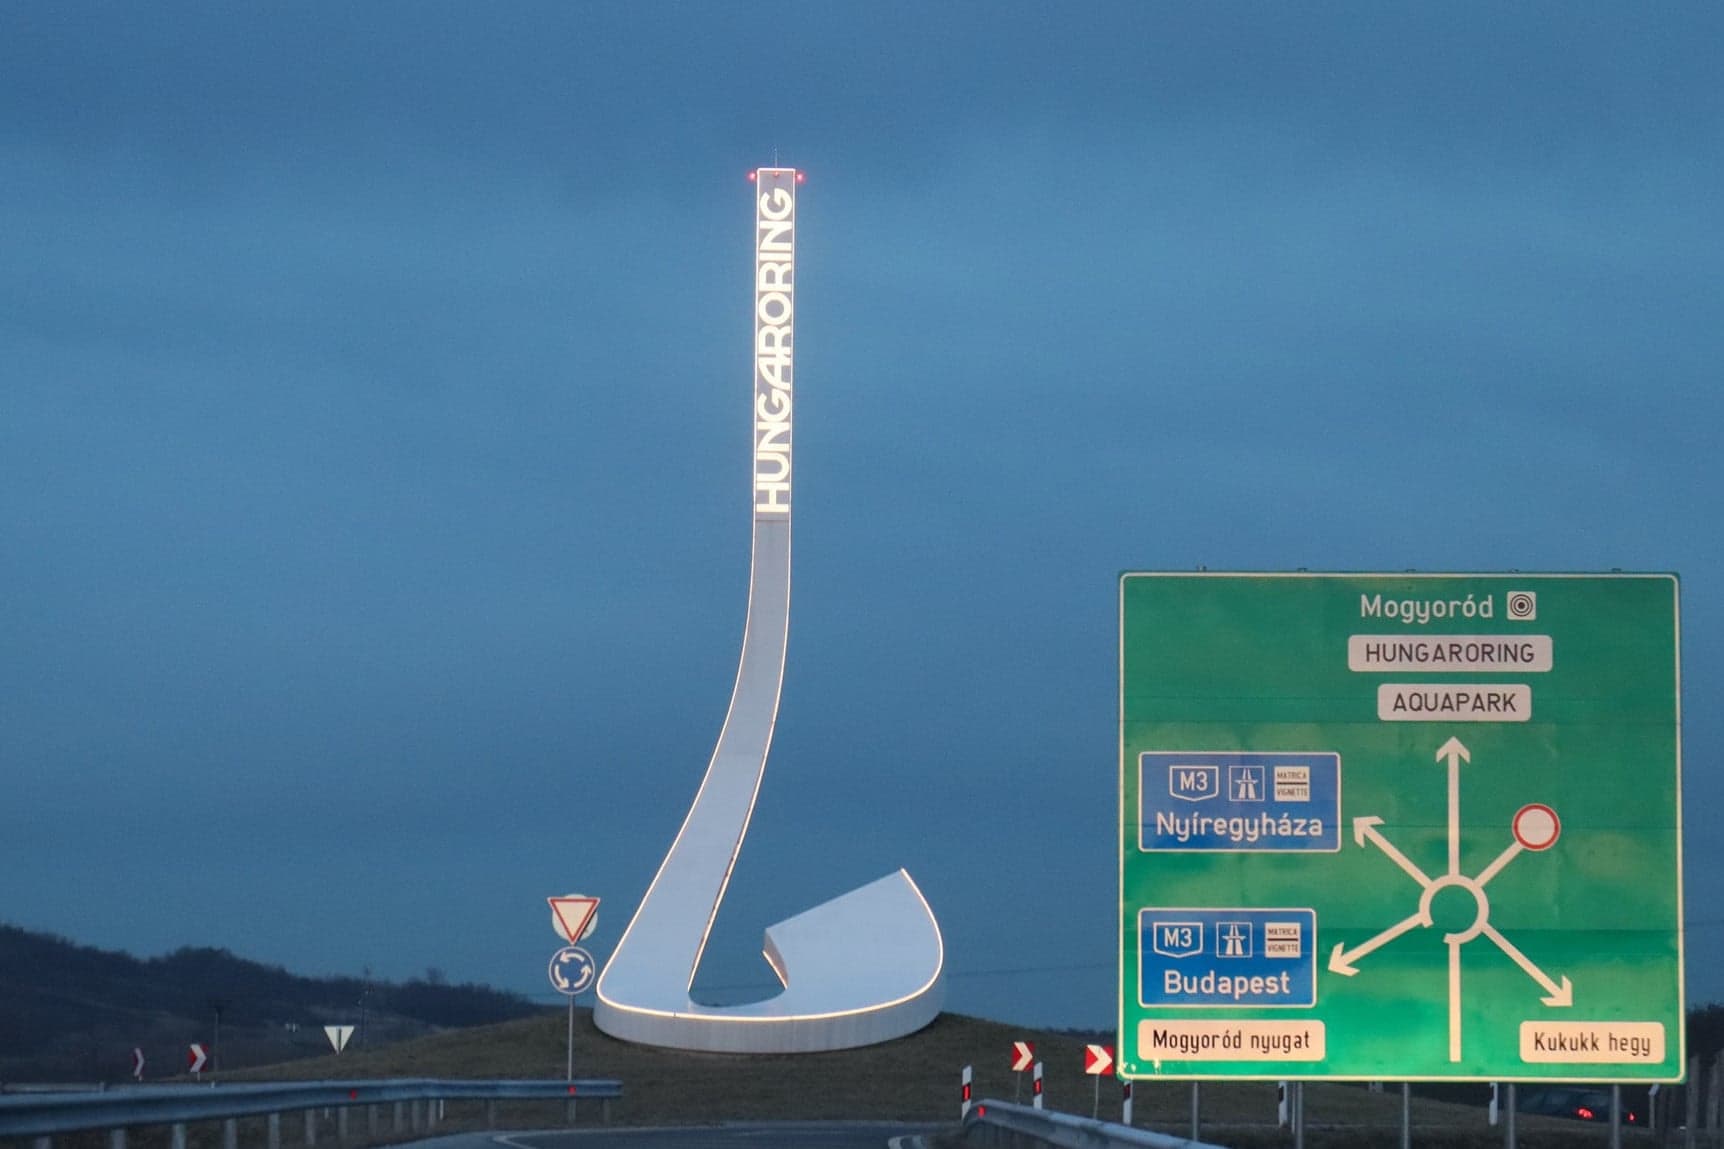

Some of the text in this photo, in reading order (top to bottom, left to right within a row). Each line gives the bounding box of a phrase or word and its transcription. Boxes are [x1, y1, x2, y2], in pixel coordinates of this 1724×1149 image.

[756, 187, 793, 513] HUNGARORING
[1360, 594, 1494, 624] Mogyoród
[1365, 643, 1535, 663] HUNGARORING
[1392, 692, 1517, 712] AQUAPARK
[1179, 770, 1208, 791] M3
[1276, 771, 1307, 779] MATRICA
[1276, 788, 1308, 797] VIGNETTE
[1156, 811, 1323, 842] Nyíregyháza
[1163, 927, 1193, 948] M3
[1267, 928, 1298, 936] MATRICA
[1267, 944, 1299, 953] VIGNETTE
[1164, 969, 1291, 1000] Budapest
[1153, 1029, 1310, 1054] Mogyoród nyugat
[1534, 1032, 1651, 1056] Kukukk hegy
